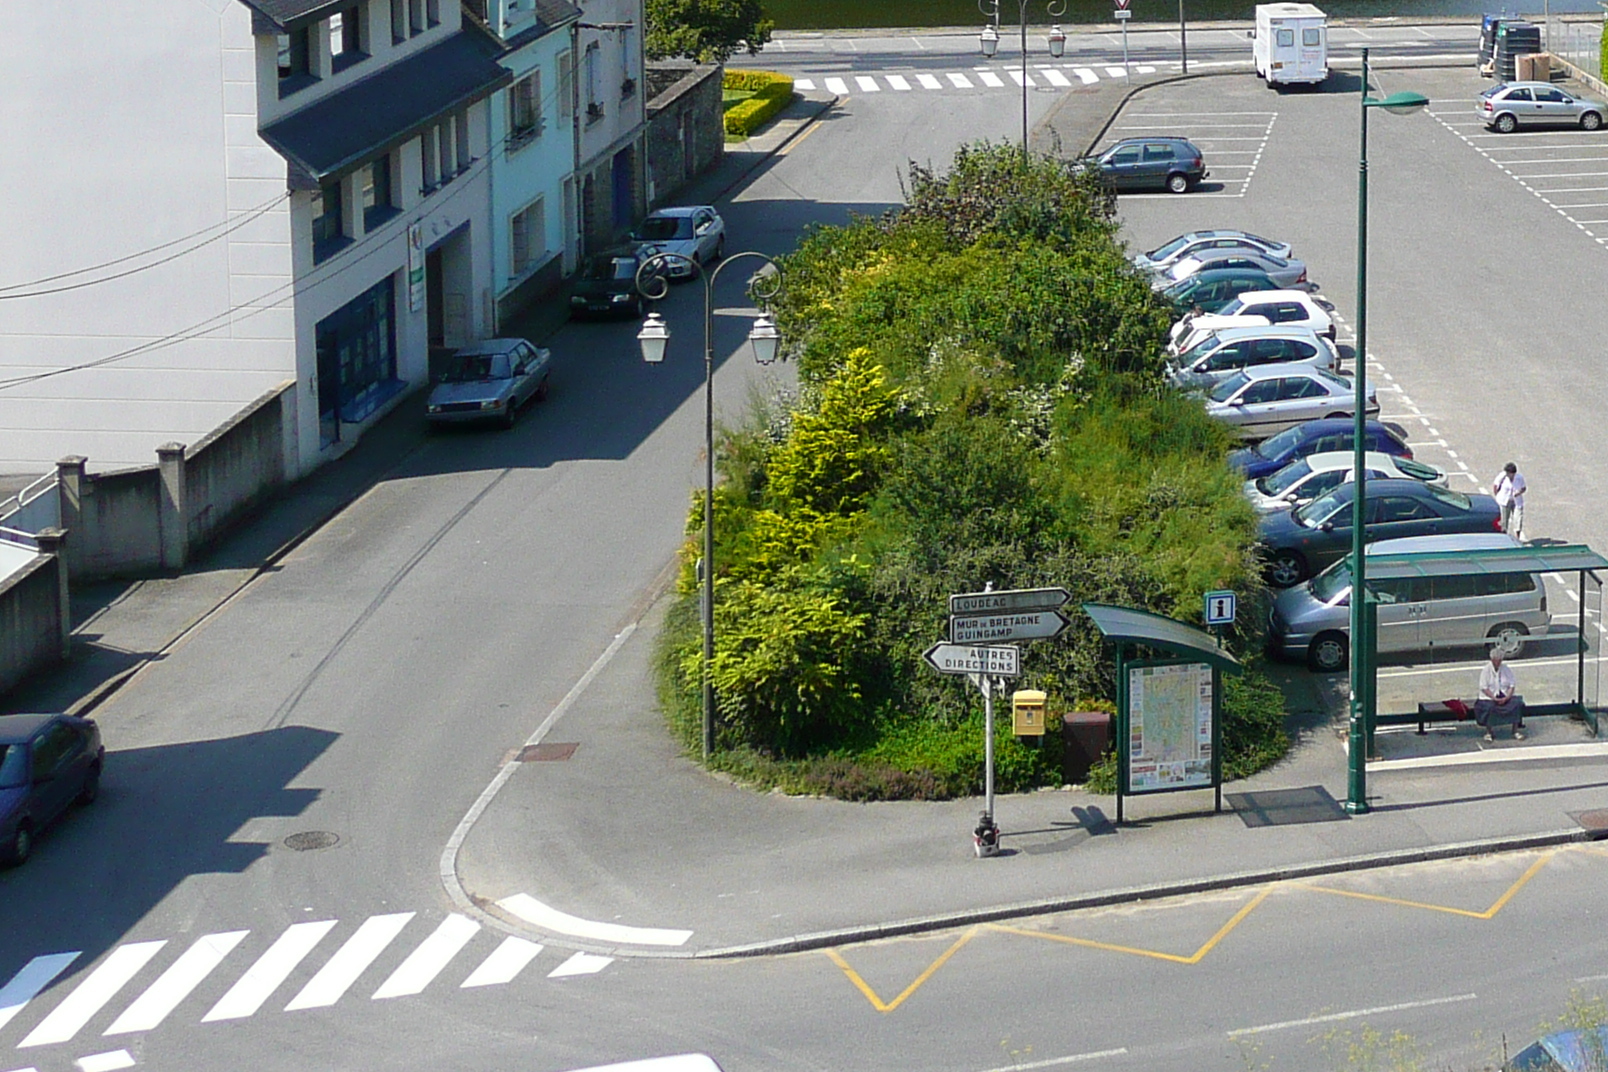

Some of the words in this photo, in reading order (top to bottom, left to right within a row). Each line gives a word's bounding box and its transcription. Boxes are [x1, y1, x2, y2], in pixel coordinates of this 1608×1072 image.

[956, 598, 1006, 610] LOUDÉAC
[956, 620, 979, 629] MUR
[989, 615, 1040, 627] BRETAGNE
[957, 628, 1012, 640] GUINGAMP
[970, 649, 1013, 660] AUTRES
[945, 659, 1013, 671] DIRECTIONS
